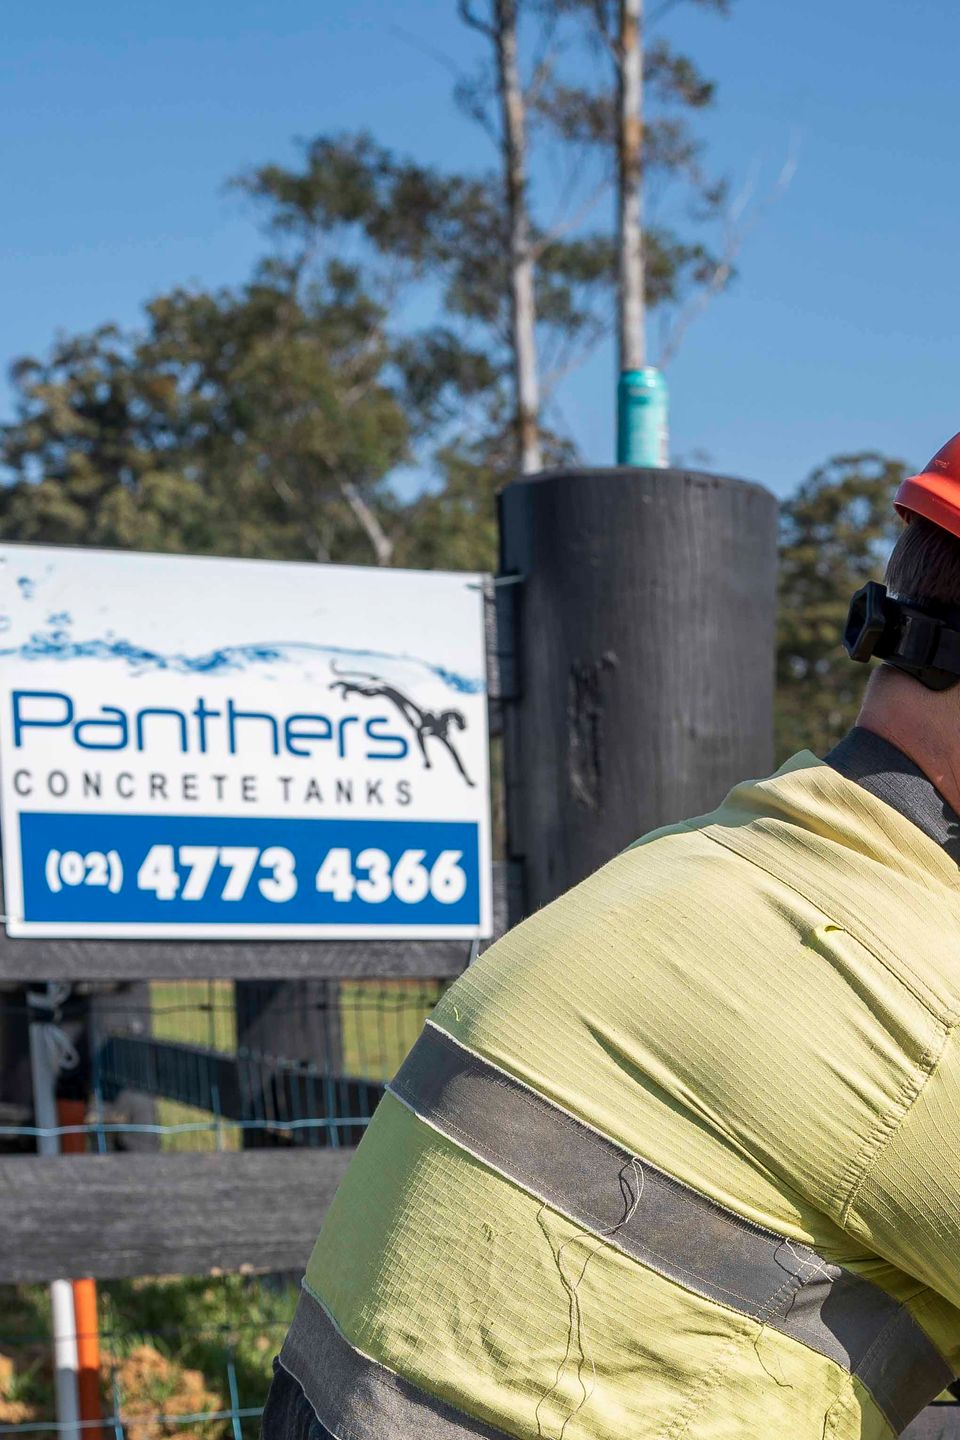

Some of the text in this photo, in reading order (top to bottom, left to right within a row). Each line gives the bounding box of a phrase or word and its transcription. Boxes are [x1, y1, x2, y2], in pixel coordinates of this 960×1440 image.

[11, 689, 409, 760] Panthers
[13, 769, 413, 807] CONCRETE TANKS
[45, 844, 467, 904] (02) 4773 4366
